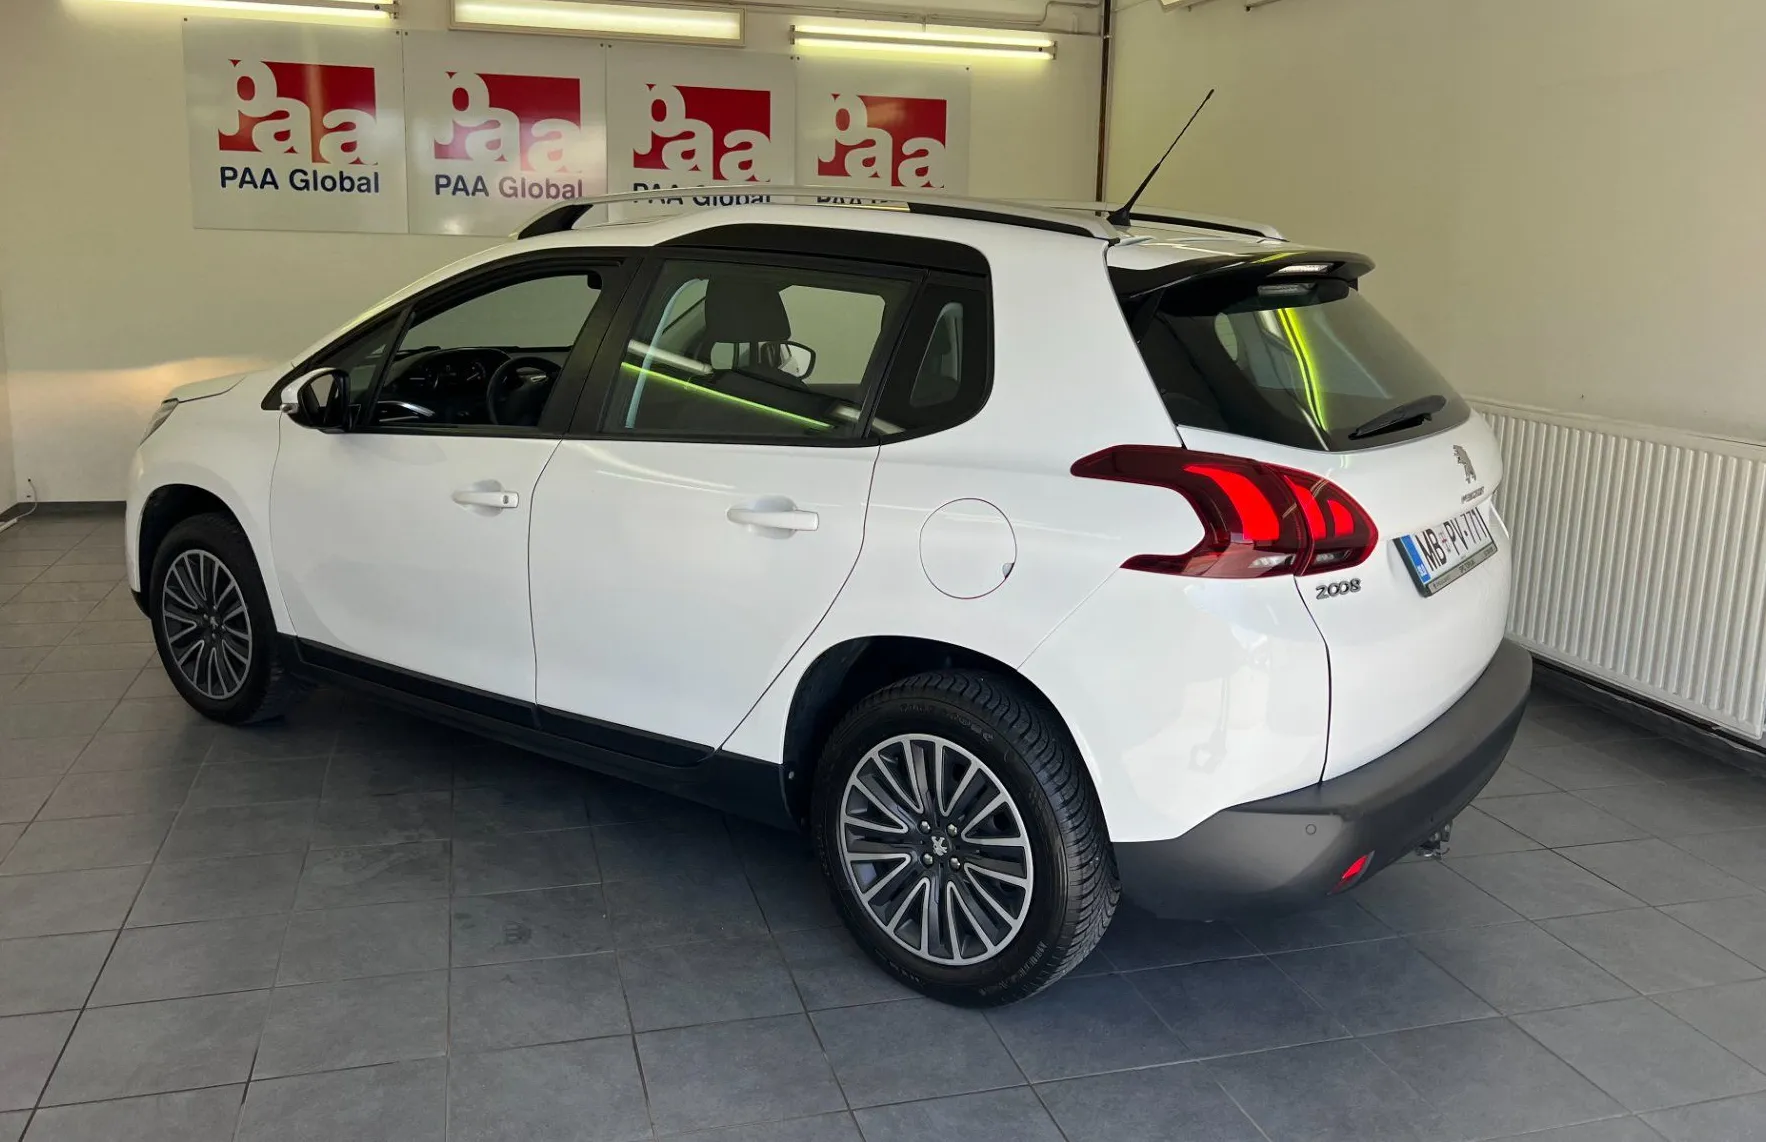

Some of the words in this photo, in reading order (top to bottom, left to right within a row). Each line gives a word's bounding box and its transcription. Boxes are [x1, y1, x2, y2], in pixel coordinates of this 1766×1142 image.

[219, 166, 279, 191] PAA
[288, 167, 380, 194] Global
[434, 173, 490, 198] PAA
[498, 175, 583, 200] Global
[1415, 528, 1447, 571] MB
[1315, 577, 1362, 600] 2008
